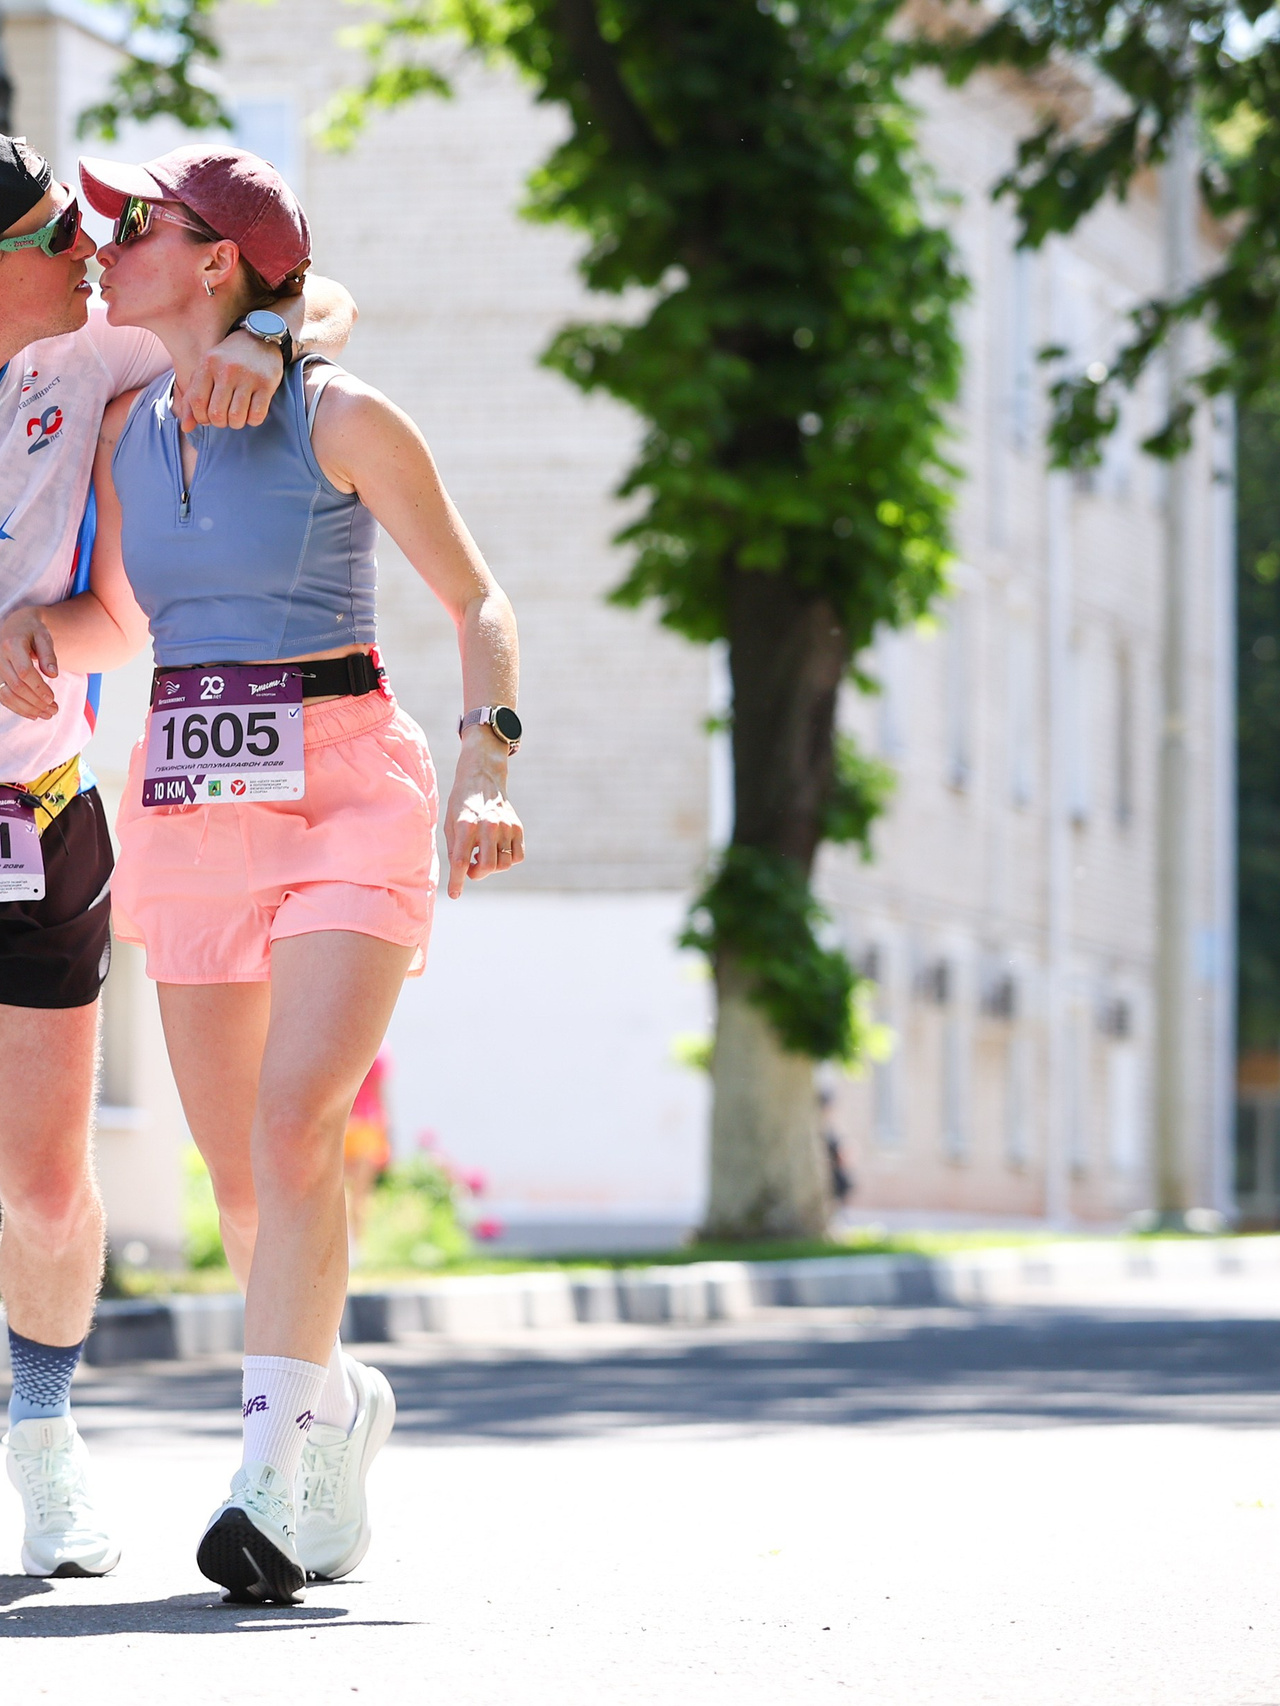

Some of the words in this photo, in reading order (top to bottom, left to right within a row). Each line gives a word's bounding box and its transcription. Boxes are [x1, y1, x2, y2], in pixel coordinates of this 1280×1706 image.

[27, 406, 63, 455] 20
[200, 675, 225, 700] 20
[162, 711, 280, 760] 1605
[197, 761, 261, 769] ПОЛУМАРАФОН
[154, 782, 164, 800] 10
